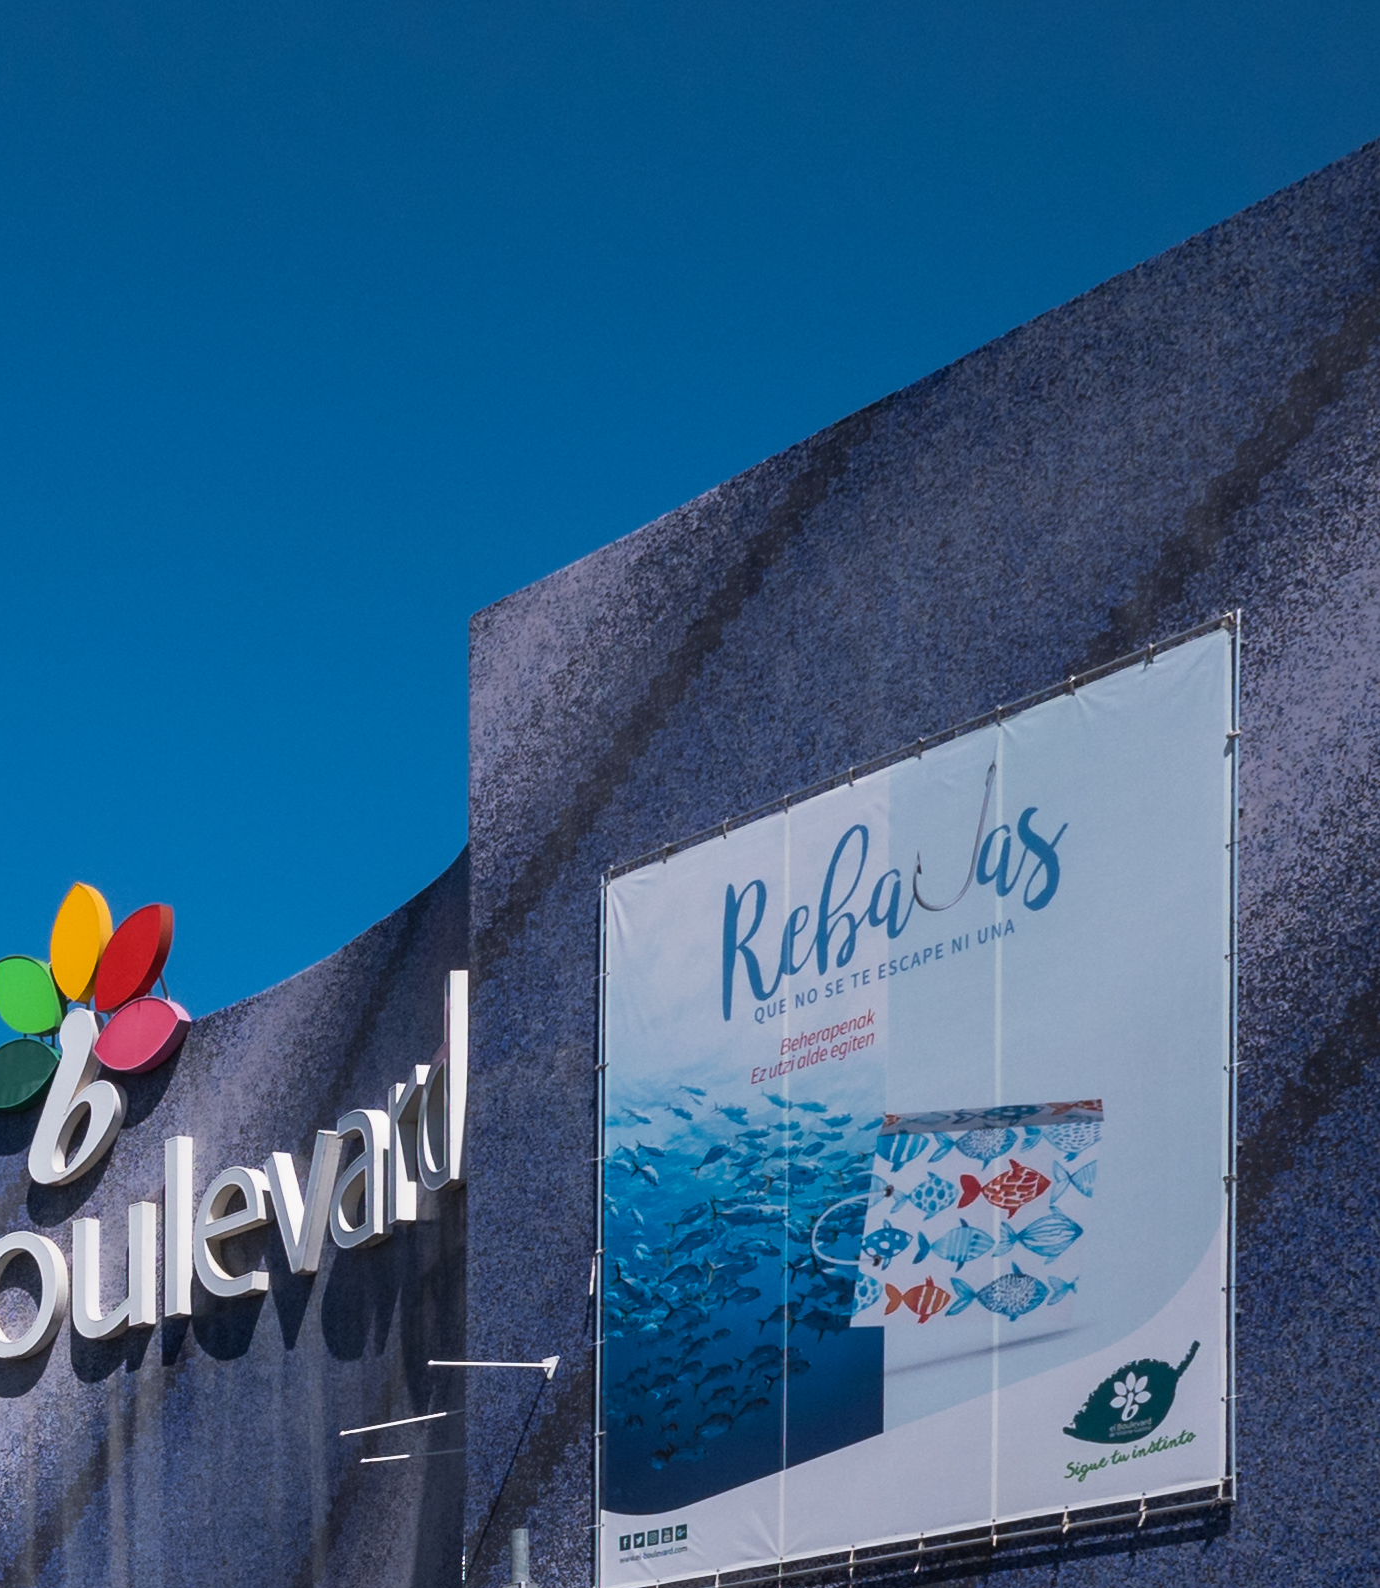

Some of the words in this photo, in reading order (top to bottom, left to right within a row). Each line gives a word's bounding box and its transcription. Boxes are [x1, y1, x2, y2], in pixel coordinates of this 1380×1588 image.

[754, 998, 787, 1024] QUE
[795, 988, 818, 1009] NO
[825, 978, 845, 998] SE
[851, 969, 871, 989] TE
[878, 942, 946, 980] ESCAPE
[950, 933, 970, 954] NI
[977, 919, 1015, 946] UNA
[780, 1009, 875, 1055] Beherapenak
[751, 1067, 767, 1085] Ez
[769, 1056, 796, 1077] utzi
[797, 1046, 828, 1069] alde
[831, 1032, 875, 1060] egiten
[1064, 1457, 1109, 1482] Sigue
[1111, 1450, 1130, 1465] tu
[1132, 1430, 1196, 1459] instinto
